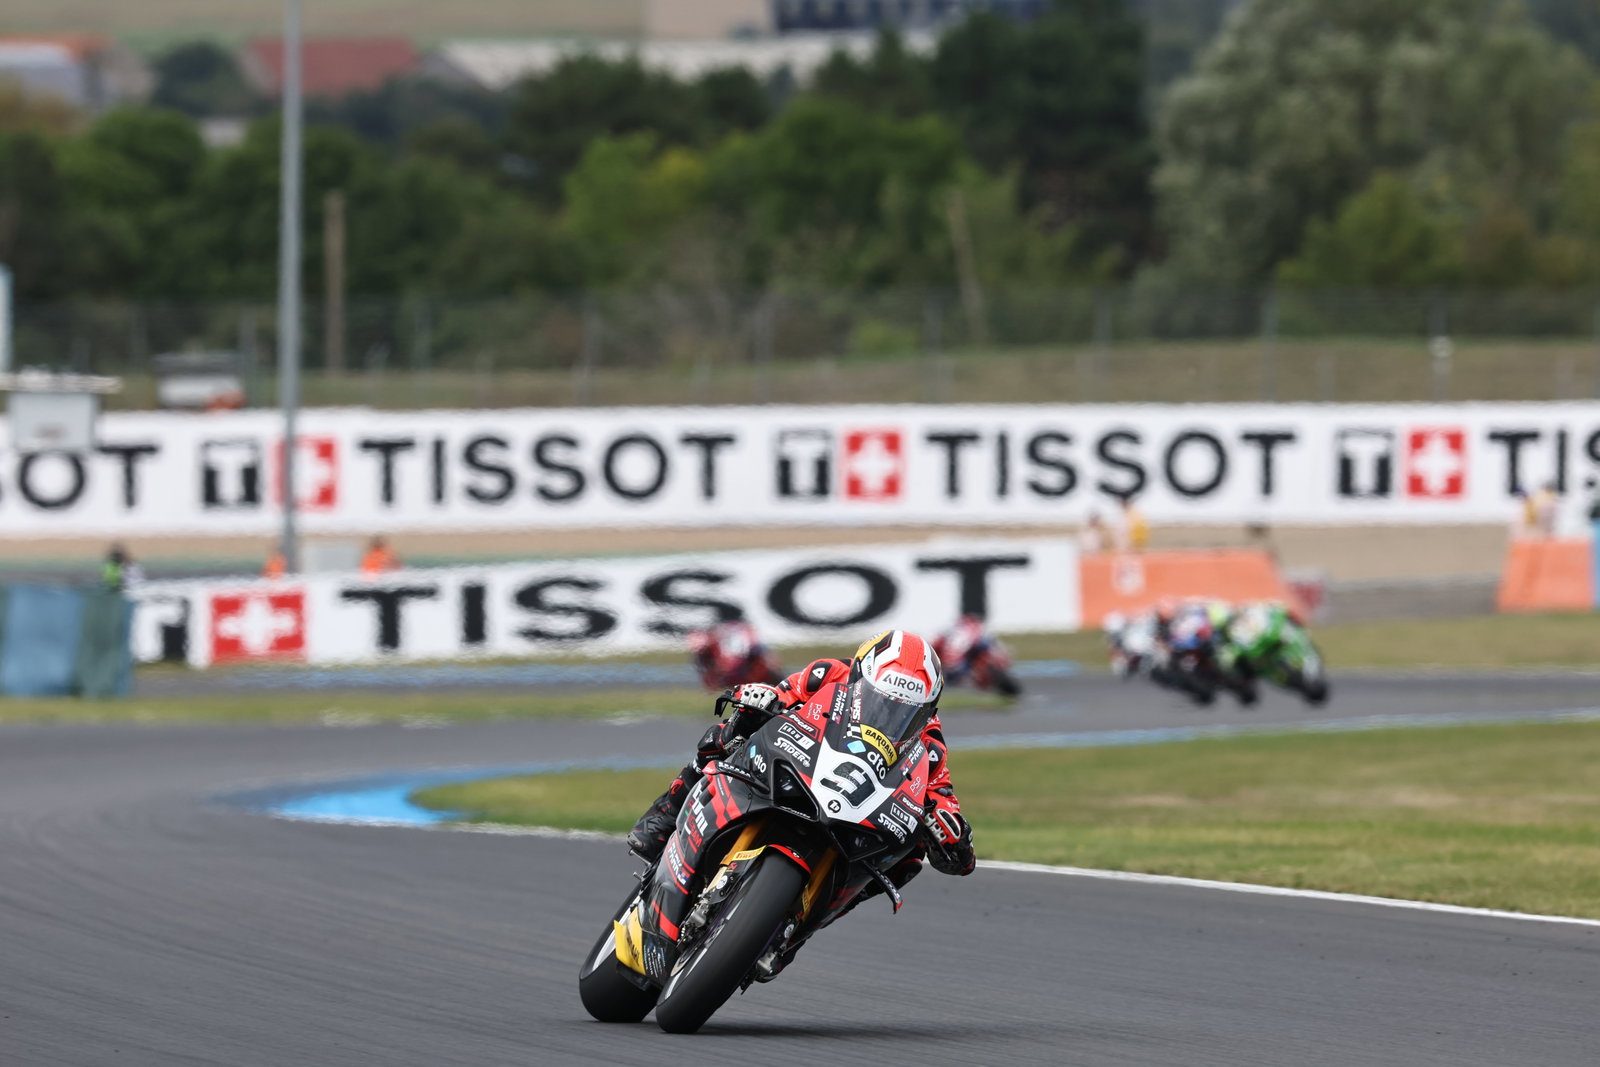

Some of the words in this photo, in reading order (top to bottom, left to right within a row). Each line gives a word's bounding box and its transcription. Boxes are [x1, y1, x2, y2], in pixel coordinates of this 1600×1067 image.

[0, 441, 160, 510] OT
[360, 433, 735, 504] TISSOT
[927, 431, 1296, 498] TISSOT
[341, 554, 1030, 650] TISSOT
[882, 673, 924, 694] AIROH
[789, 713, 815, 732] DUCATI
[864, 729, 895, 761] BARDAHL
[754, 754, 767, 773] dto
[866, 751, 886, 780] dto
[902, 797, 924, 815] DUCATI
